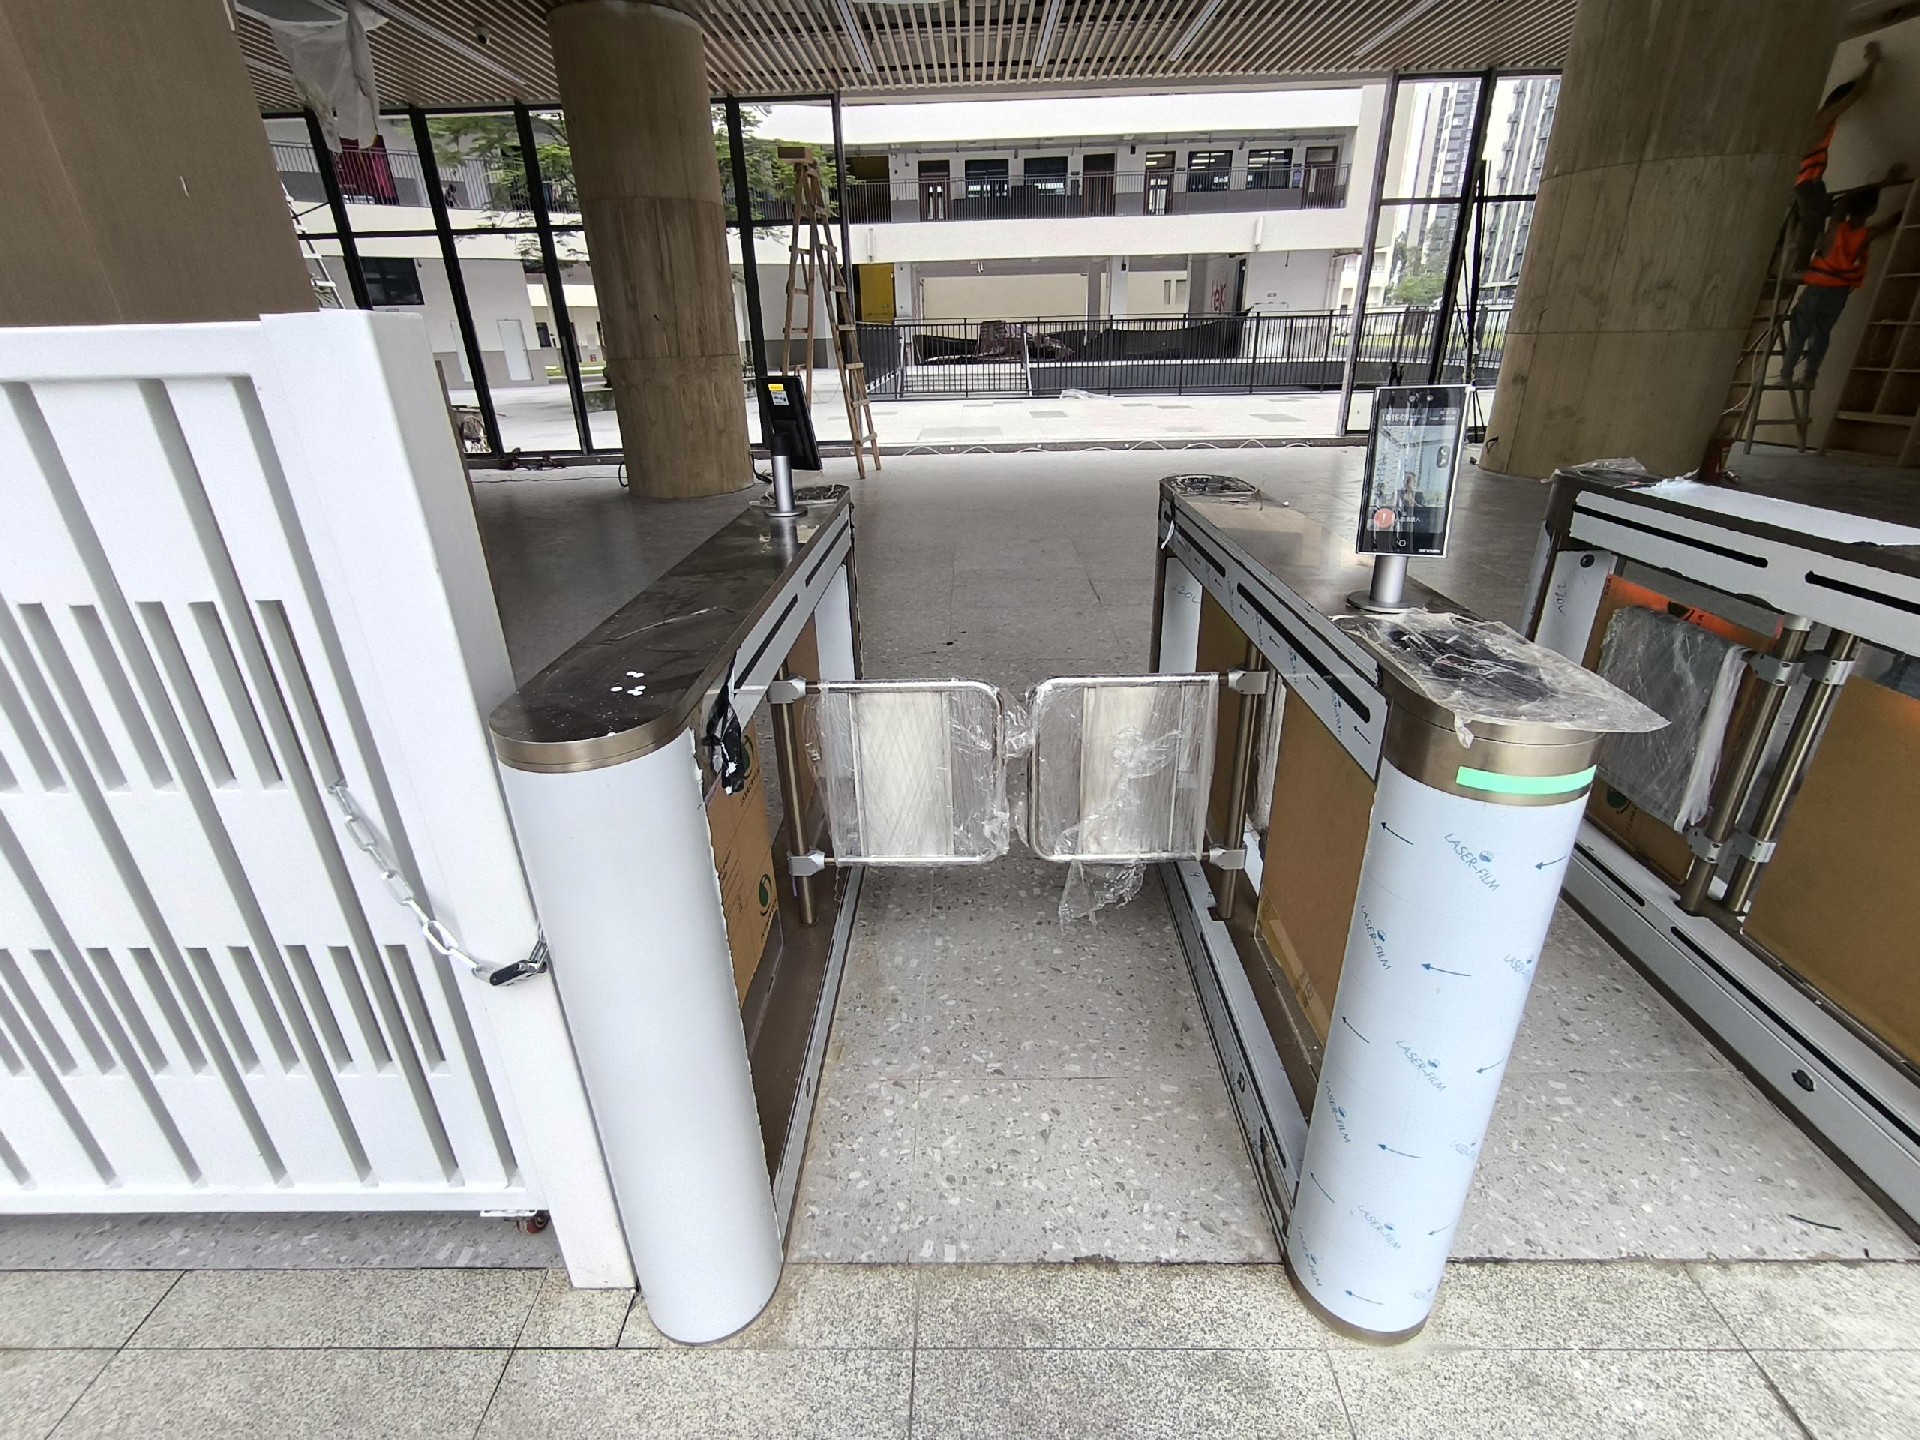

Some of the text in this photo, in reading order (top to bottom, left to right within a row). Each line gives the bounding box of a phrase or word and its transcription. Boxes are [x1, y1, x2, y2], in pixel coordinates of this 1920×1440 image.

[1444, 833, 1500, 892] LASER-FILM
[1361, 905, 1392, 971] LASER-FILM
[1395, 1040, 1447, 1092] LASER-FILM
